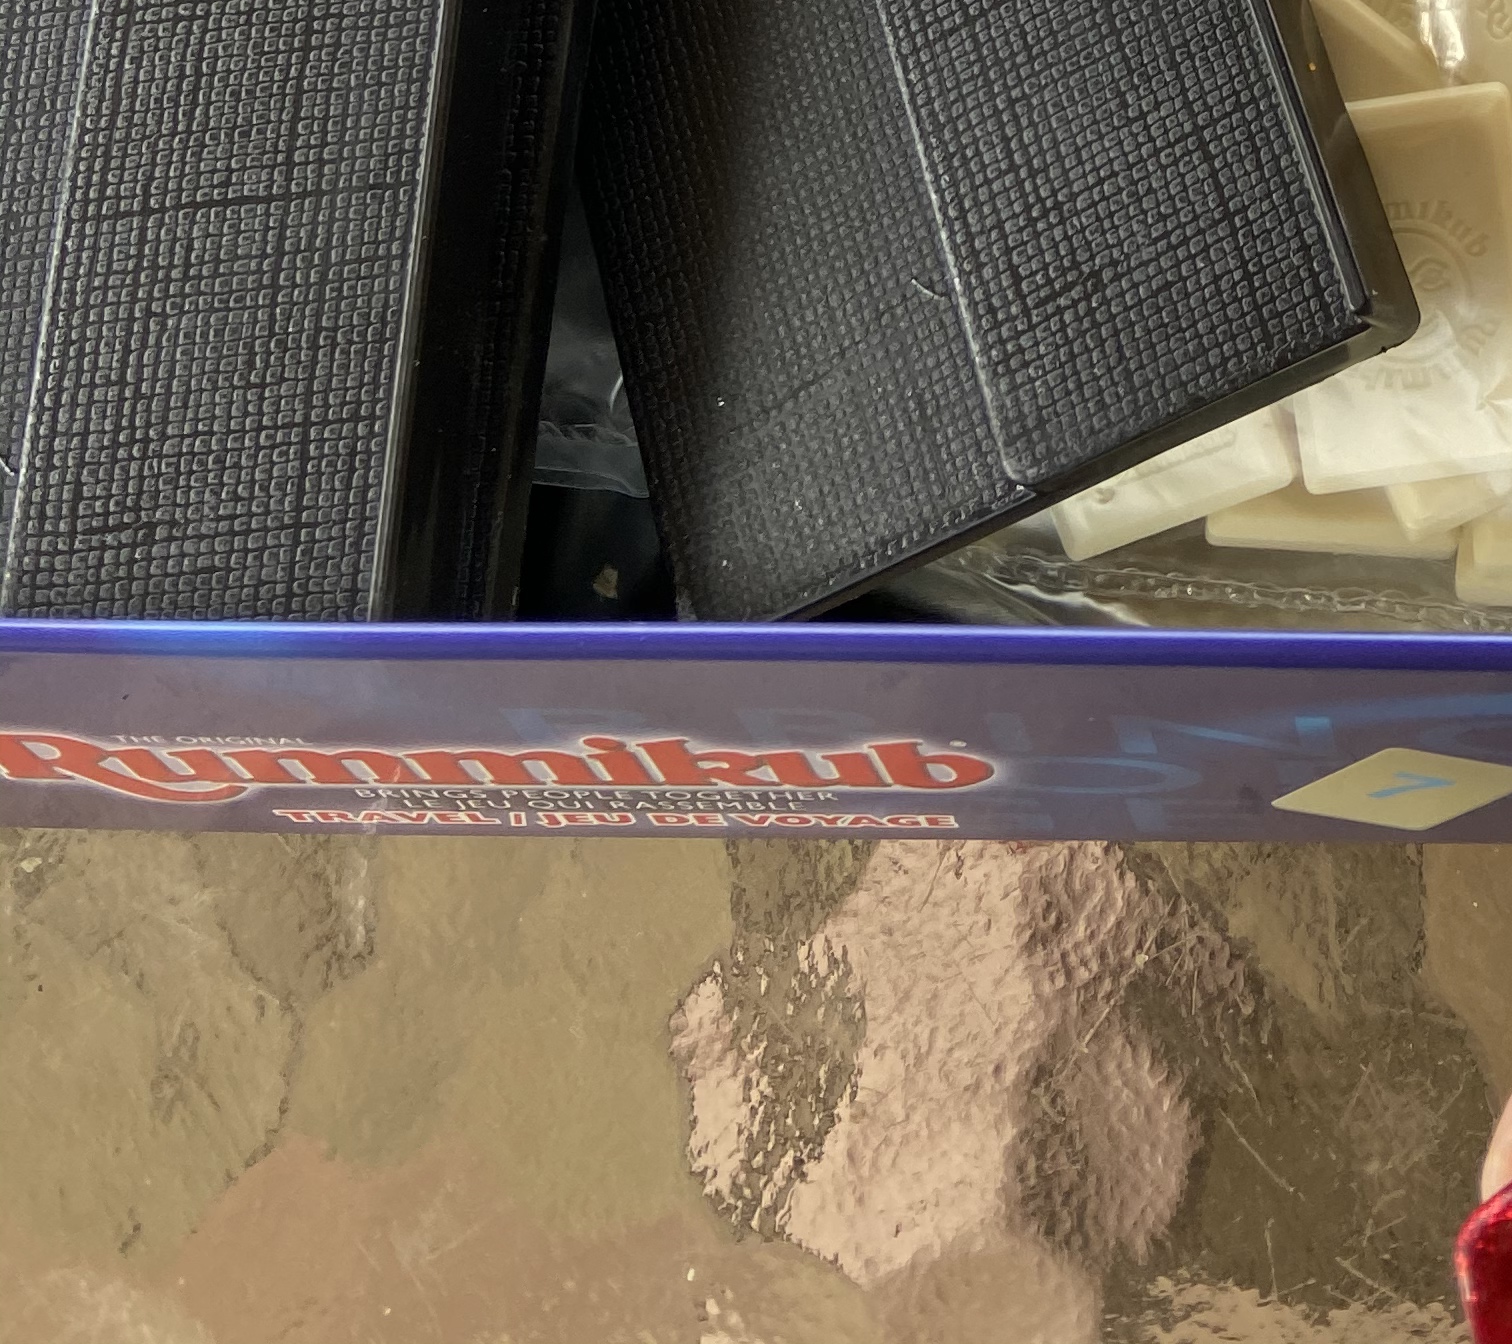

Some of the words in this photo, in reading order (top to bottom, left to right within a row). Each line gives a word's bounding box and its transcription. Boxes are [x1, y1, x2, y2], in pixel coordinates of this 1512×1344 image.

[114, 734, 155, 745] THE
[175, 734, 313, 746] ORIGINAL
[0, 733, 995, 802] Rummikub
[355, 787, 488, 800] BRINGS
[502, 789, 633, 802] PEOPLE
[646, 790, 839, 803] TOGETHER
[404, 799, 444, 809] LE
[456, 799, 511, 811] JEU
[526, 799, 594, 811] QUI
[610, 800, 808, 812] RASSEMBLE
[273, 810, 501, 824] TRAVEL
[537, 812, 635, 827] JEU
[648, 812, 729, 828] DE
[743, 813, 960, 828] VOYAGE
